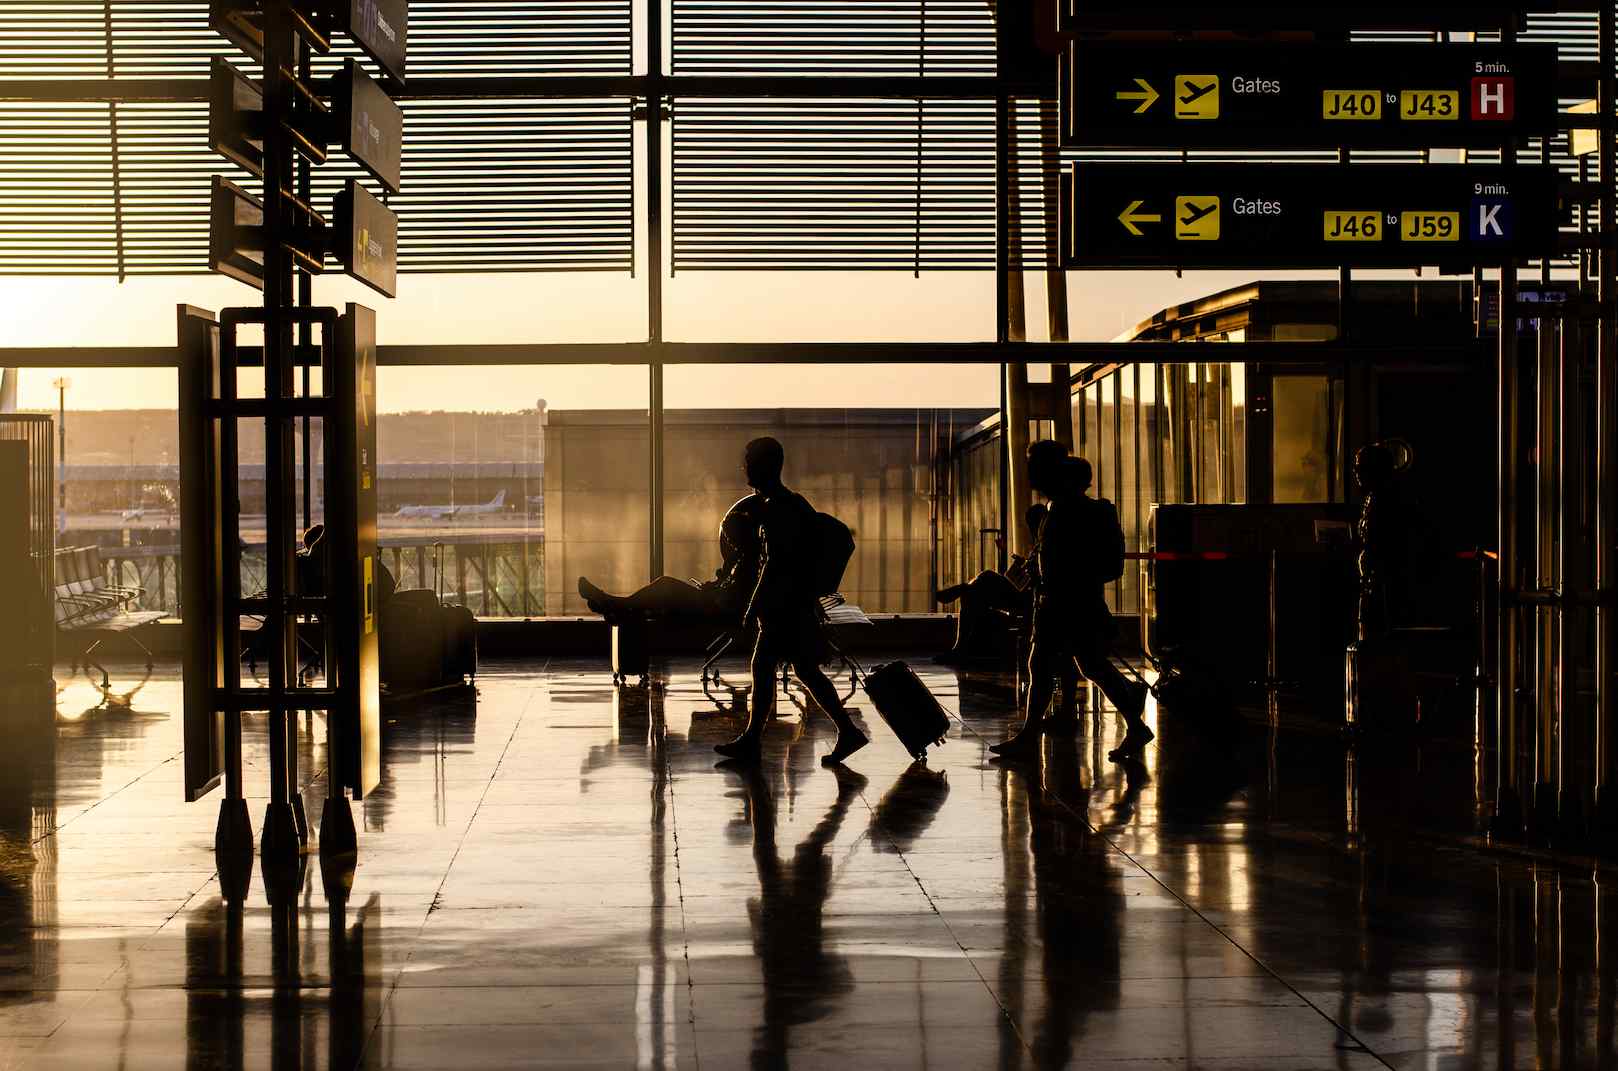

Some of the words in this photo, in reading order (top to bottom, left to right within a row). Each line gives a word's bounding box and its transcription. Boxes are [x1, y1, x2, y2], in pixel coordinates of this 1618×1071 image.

[1475, 62, 1482, 73] 5
[1485, 62, 1509, 73] min.
[1232, 76, 1281, 93] Gates
[1329, 94, 1376, 116] J40
[1386, 93, 1397, 103] to
[1407, 94, 1453, 116] J43
[1480, 83, 1504, 114] H
[1475, 183, 1482, 194] 9
[1484, 183, 1508, 194] min.
[1232, 197, 1282, 215] Gates
[1330, 215, 1377, 237] J46
[1387, 213, 1398, 224] to
[1409, 215, 1453, 237] J59
[1479, 204, 1504, 236] K
